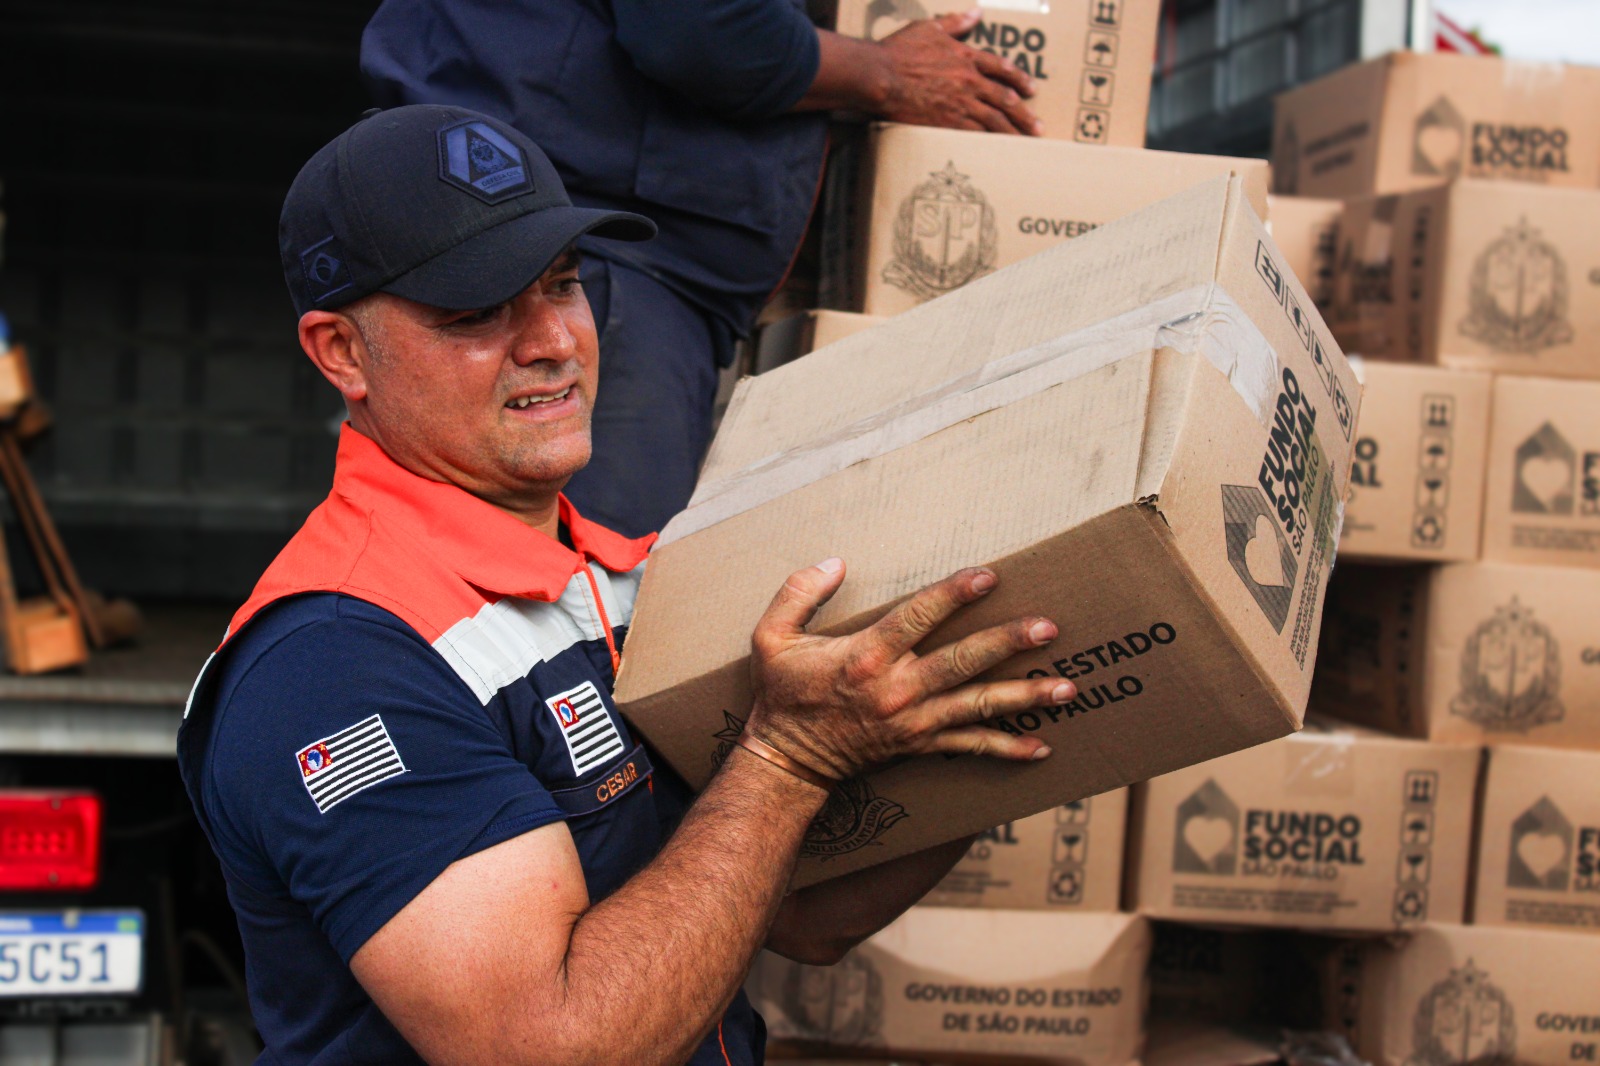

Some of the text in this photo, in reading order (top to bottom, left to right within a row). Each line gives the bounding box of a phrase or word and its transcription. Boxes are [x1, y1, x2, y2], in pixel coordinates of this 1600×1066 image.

[962, 19, 1047, 52] NDO
[1473, 122, 1569, 149] FUNDO
[1473, 146, 1570, 172] SOCIAL
[1258, 367, 1300, 508] FUNDO
[1277, 392, 1317, 533] SOCIAL
[1292, 508, 1307, 556] SÃO
[1302, 445, 1319, 513] PAULO
[1053, 622, 1177, 680] ESTADO
[596, 762, 639, 803] CESAR
[1246, 810, 1362, 840] FUNDO
[1244, 836, 1365, 865] SOCIAL
[1242, 862, 1338, 881] SÃO PAULO
[0, 942, 109, 983] 5C51
[905, 982, 1122, 1008] GOVERNO DO ESTADO
[943, 1011, 1090, 1036] DE SÃO PAULO
[1571, 1042, 1596, 1062] DE
